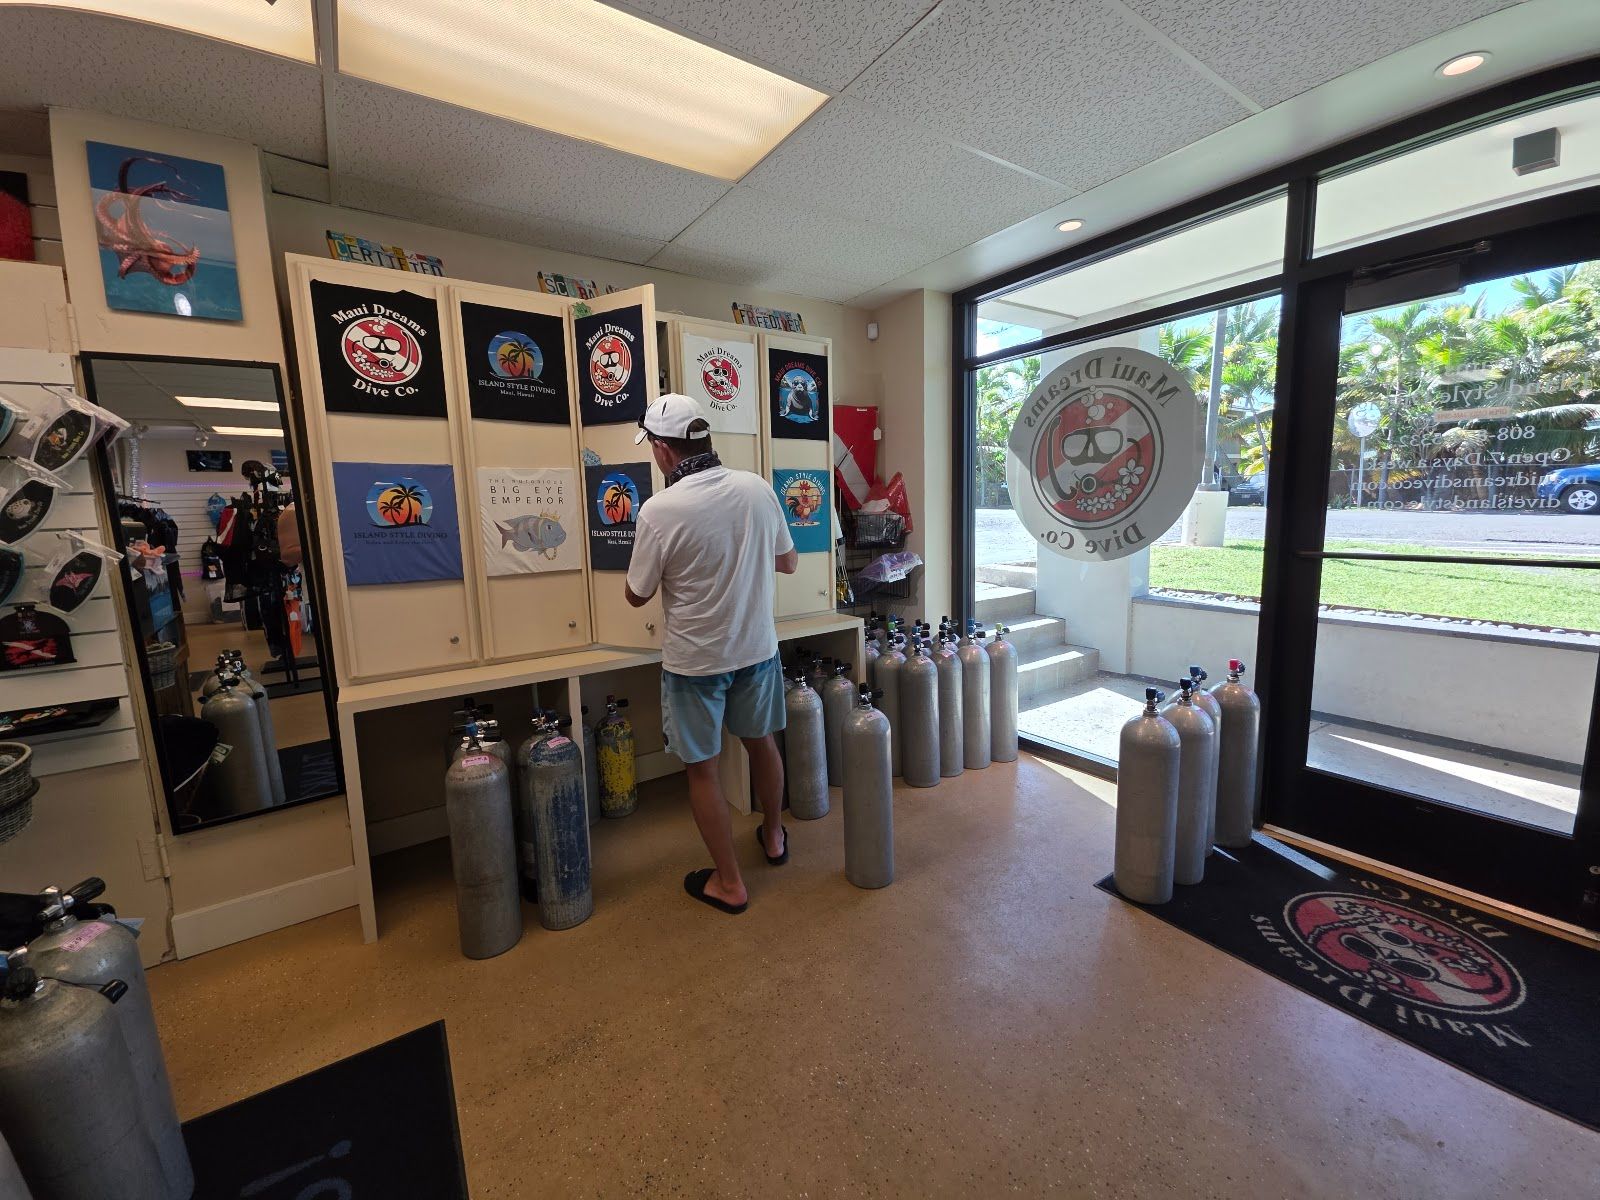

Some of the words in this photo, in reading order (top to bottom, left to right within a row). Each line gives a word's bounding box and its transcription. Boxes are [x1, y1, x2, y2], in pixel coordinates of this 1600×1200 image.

[331, 303, 369, 325] Maui
[373, 303, 427, 337] Dreams
[739, 308, 803, 332] FREEDIVER
[585, 326, 604, 350] Maui
[604, 323, 635, 342] Dreams
[696, 347, 716, 365] Maui
[716, 346, 743, 369] Dreams
[352, 378, 390, 397] Dive
[394, 386, 419, 397] Co.
[478, 379, 505, 389] ISLAND
[506, 382, 529, 391] STYLE
[530, 385, 556, 395] DIVING
[594, 392, 614, 407] Dive
[615, 393, 630, 404] Co.
[709, 400, 726, 412] Dive
[726, 402, 738, 412] Co.
[490, 485, 520, 494] BIG
[534, 486, 563, 494] EYE
[780, 476, 794, 496] ISLAND
[795, 472, 812, 480] STYLE
[491, 496, 564, 505] EMPEROR
[353, 531, 388, 539] ISLAND
[389, 531, 416, 539] STYLE
[1350, 877, 1411, 901] Co.
[1422, 898, 1510, 940] Dive
[1250, 914, 1375, 1009] Dreams
[1395, 1004, 1532, 1048] Maui
